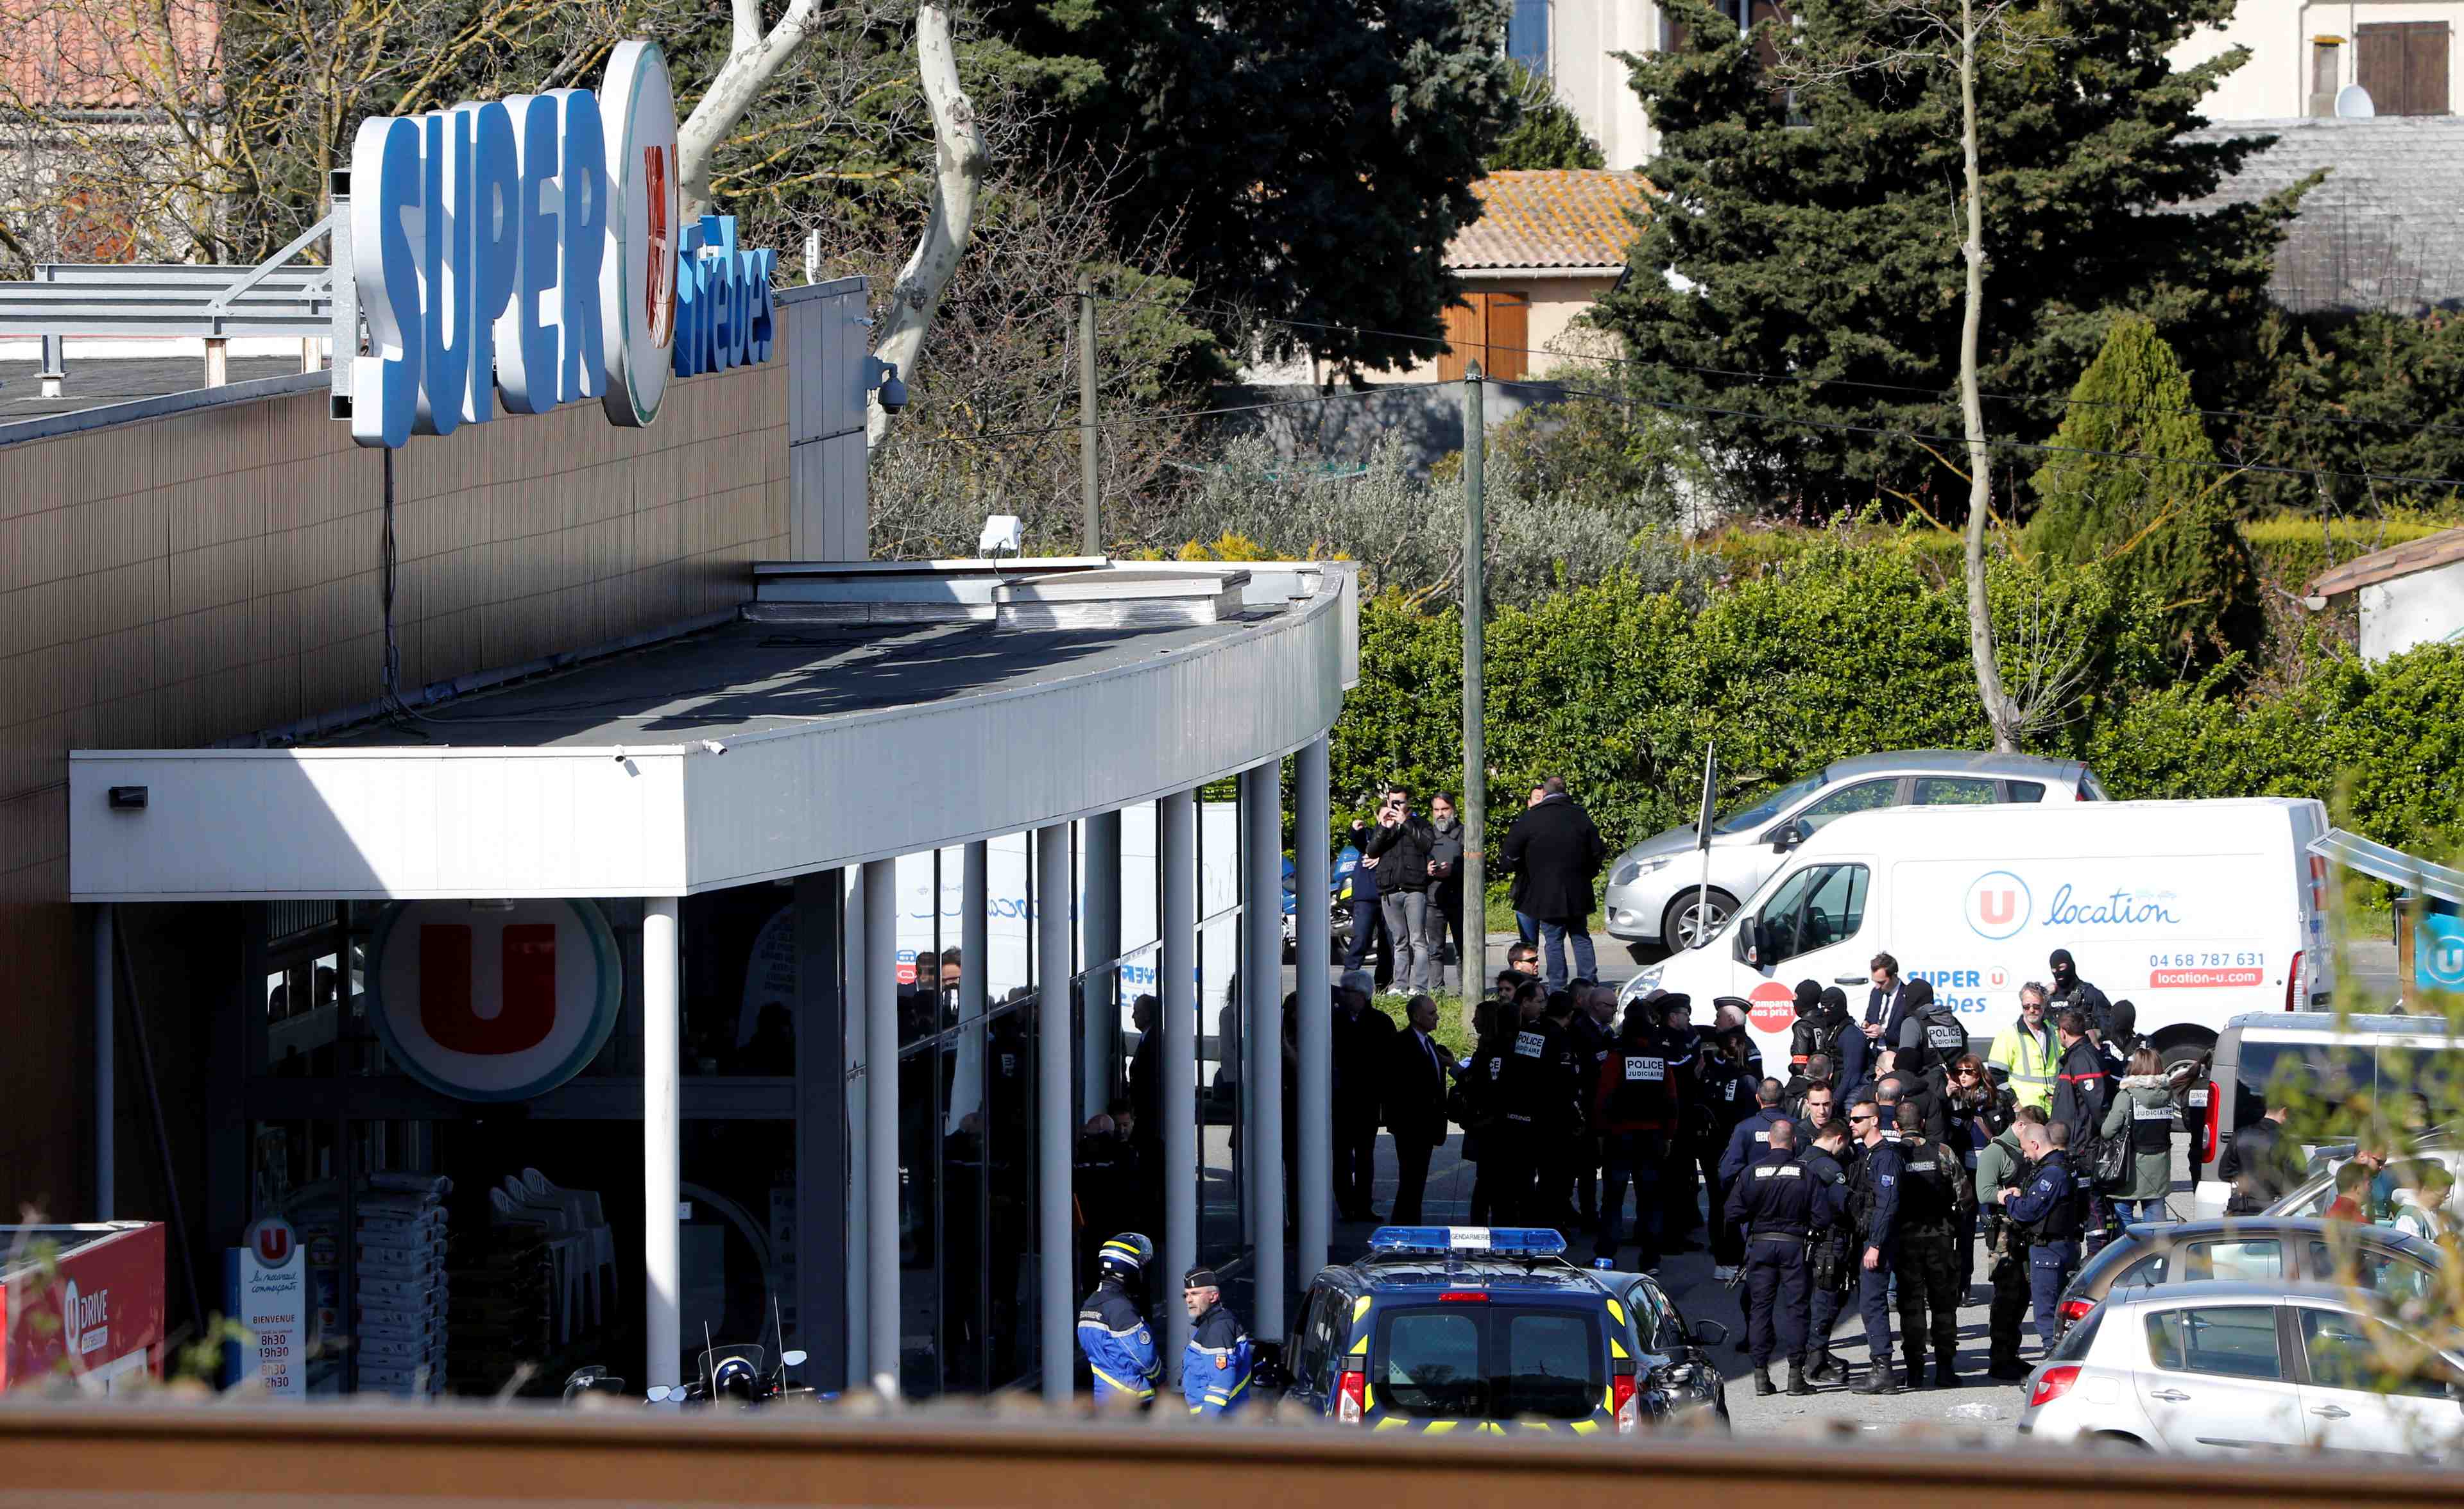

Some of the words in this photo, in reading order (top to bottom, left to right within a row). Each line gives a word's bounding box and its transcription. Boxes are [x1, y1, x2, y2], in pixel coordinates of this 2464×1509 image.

[379, 89, 607, 448] SUPER
[1980, 891, 2015, 925] U
[2042, 883, 2182, 926] location
[2150, 955, 2169, 967] 04
[2175, 954, 2194, 966] 68
[2200, 953, 2230, 966] 787
[2236, 951, 2264, 966] 631
[1991, 973, 2004, 985] U
[2157, 972, 2256, 984] location-u.com
[420, 924, 556, 1055] U
[1933, 993, 1987, 1013] èbes
[1769, 1007, 1788, 1019] prix
[1929, 1028, 1961, 1037] POLICE
[1517, 1034, 1544, 1047] POLICE
[1627, 1059, 1664, 1070] POLICE
[2135, 1108, 2173, 1116] JUDICIAIRE
[260, 1228, 287, 1260] U
[81, 1288, 108, 1329] DRIVE
[252, 1313, 296, 1324] BIENVENUE
[261, 1334, 286, 1346] 8h30
[259, 1347, 289, 1358] 19h30
[259, 1376, 289, 1388] 2h30
